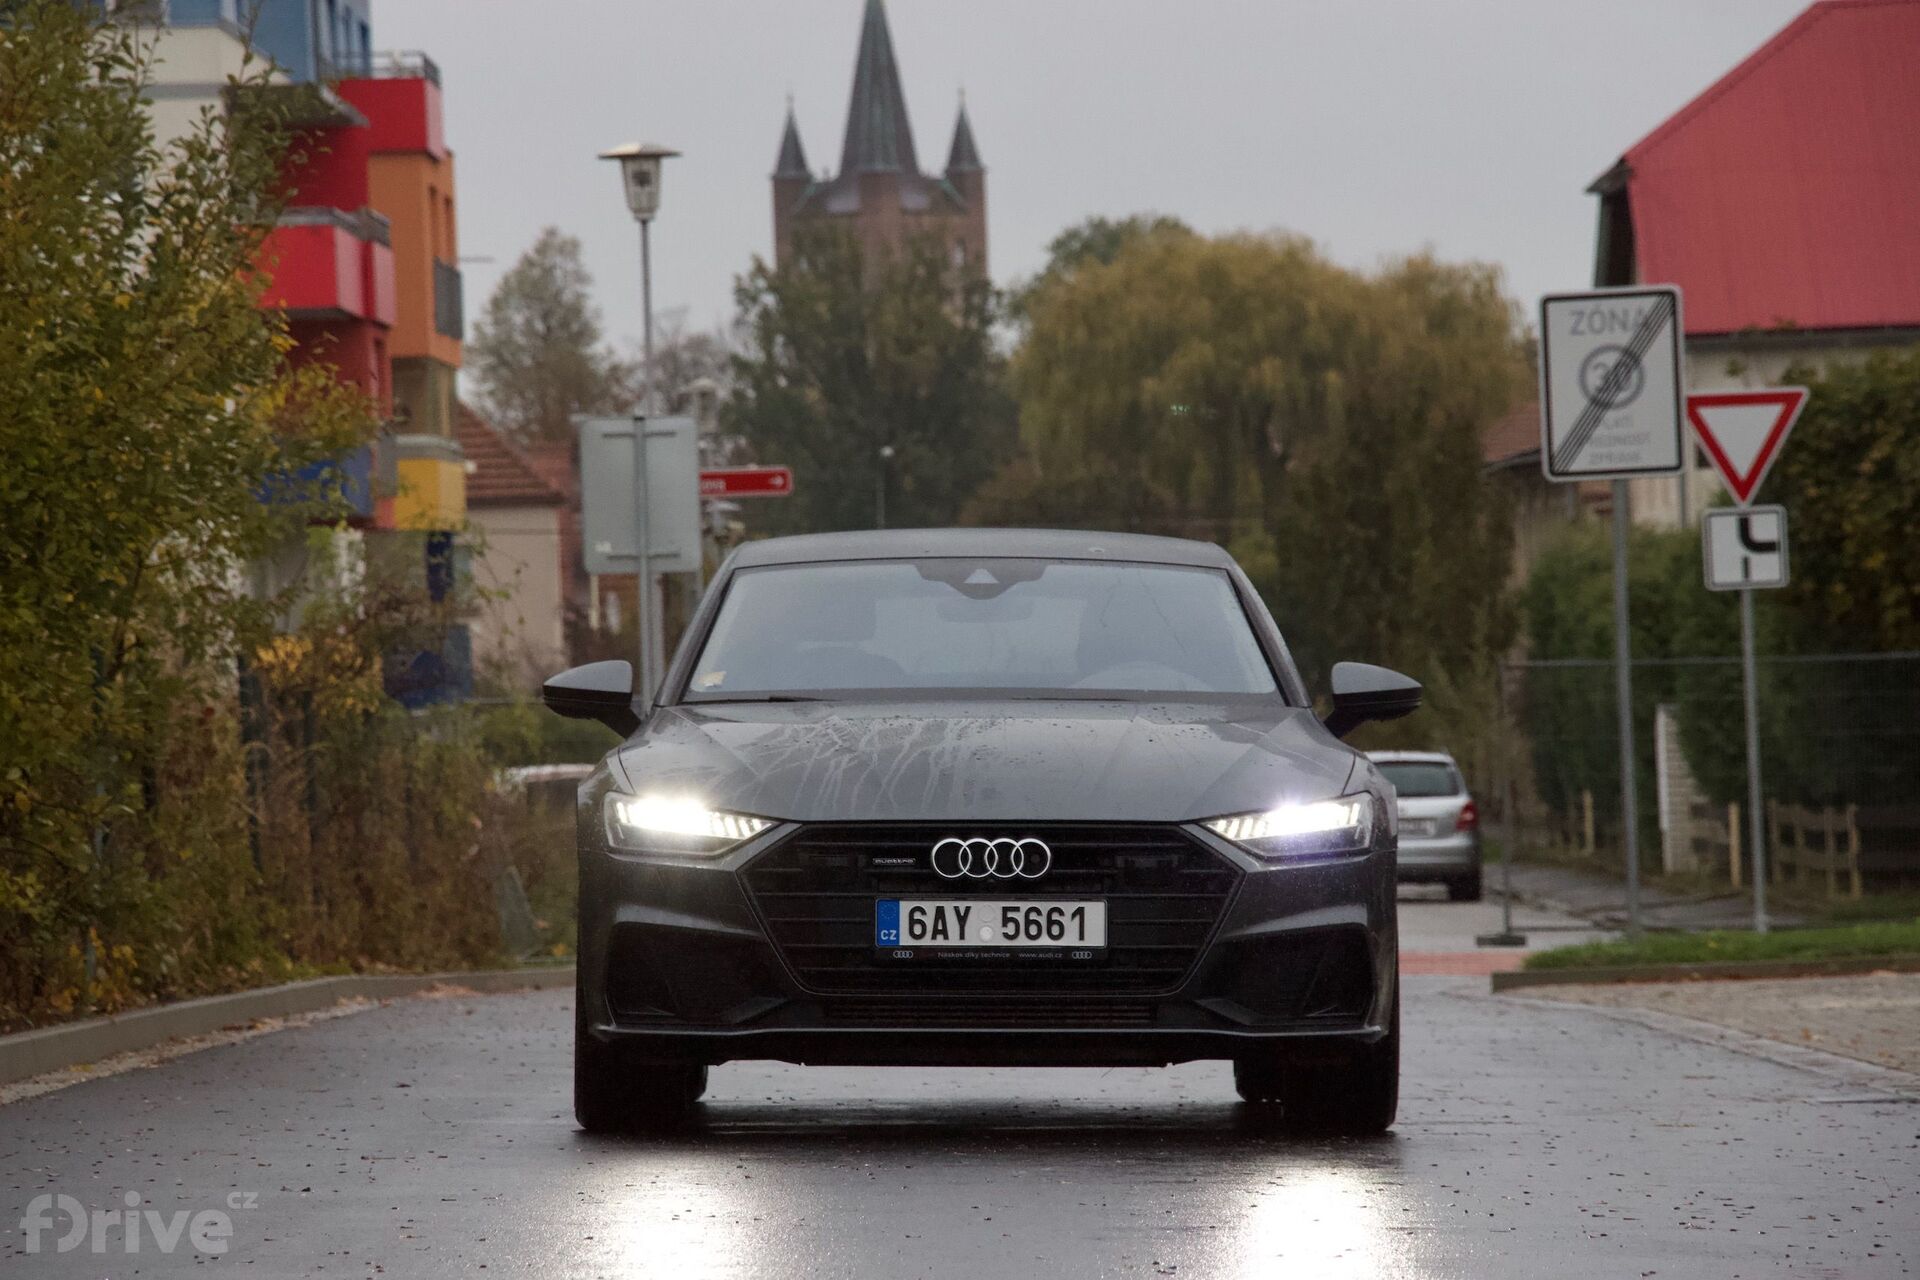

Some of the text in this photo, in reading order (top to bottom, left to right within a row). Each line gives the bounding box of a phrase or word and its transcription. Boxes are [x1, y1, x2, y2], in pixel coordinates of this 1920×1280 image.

[908, 906, 1086, 941] 6AY 5661
[880, 929, 897, 941] CZ
[981, 951, 1010, 959] technice
[1019, 951, 1064, 959] www.audi.cz
